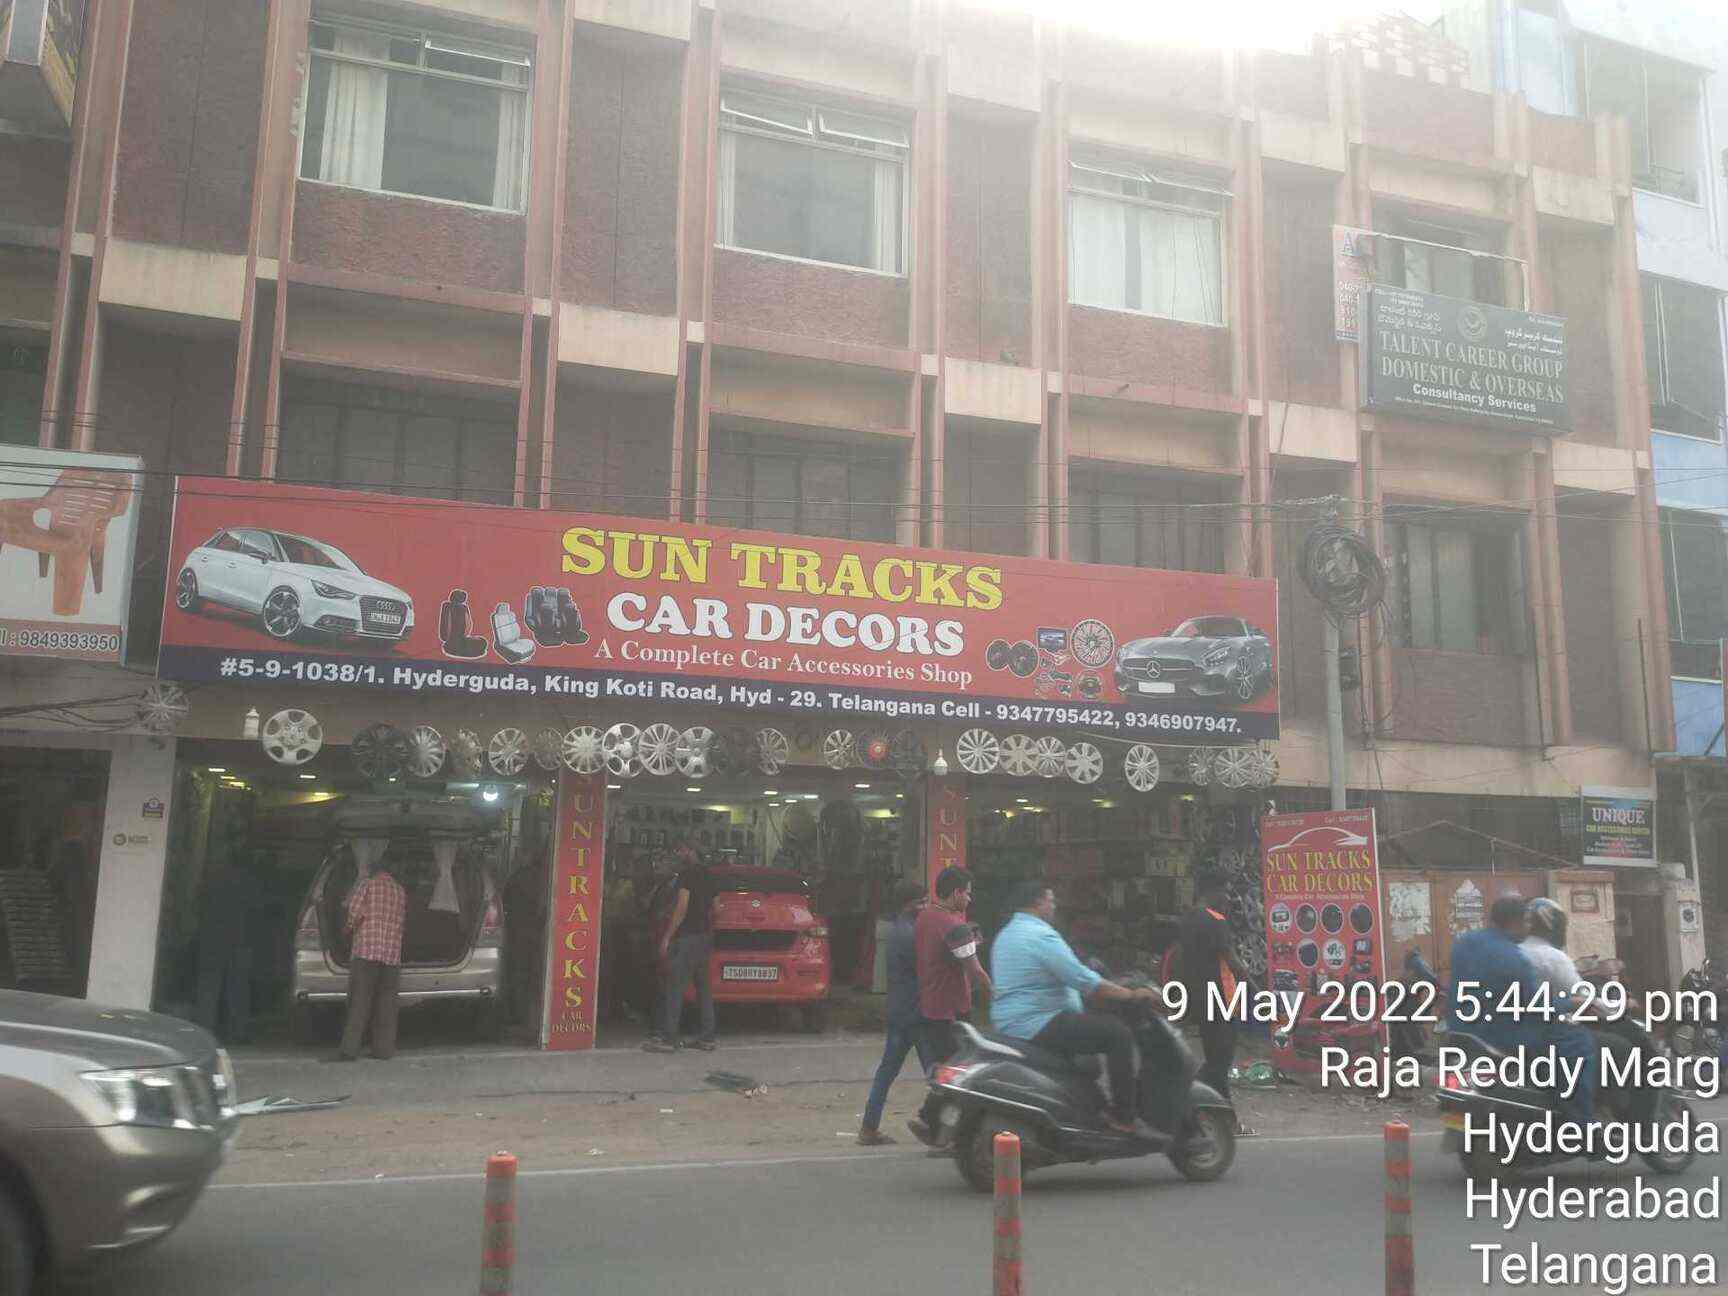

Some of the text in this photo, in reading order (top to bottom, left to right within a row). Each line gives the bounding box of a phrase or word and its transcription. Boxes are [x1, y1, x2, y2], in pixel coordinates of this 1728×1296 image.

[1380, 331, 1441, 360] TALENT
[1446, 342, 1508, 369] CAREER
[1512, 353, 1562, 379] GROUP
[1382, 356, 1564, 402] DOMESTIC & OVERSEAS
[1413, 384, 1485, 407] Consultancy
[1488, 395, 1537, 413] Services
[562, 526, 1004, 610] SUN TRACKS
[19, 629, 119, 652] 9849393950
[607, 592, 964, 656] CAR DECORS
[594, 637, 972, 690] A Complete Car Accessories Shop
[220, 657, 385, 684] #5-9-1038/1.
[393, 667, 537, 695] Hyderguda,
[545, 674, 599, 698] King
[606, 677, 653, 698] Koti
[660, 681, 723, 705] Road,
[731, 686, 771, 708] Hyd
[790, 690, 822, 708] 29.
[829, 693, 936, 716] Telangana
[941, 700, 980, 718] Cell
[996, 703, 1120, 729] 9347795422,
[1124, 712, 1242, 733] 9346907947.
[1592, 807, 1646, 825] UNIQUE
[1267, 849, 1370, 872] SUN TRACKS
[1267, 872, 1373, 896] CAR DECORS
